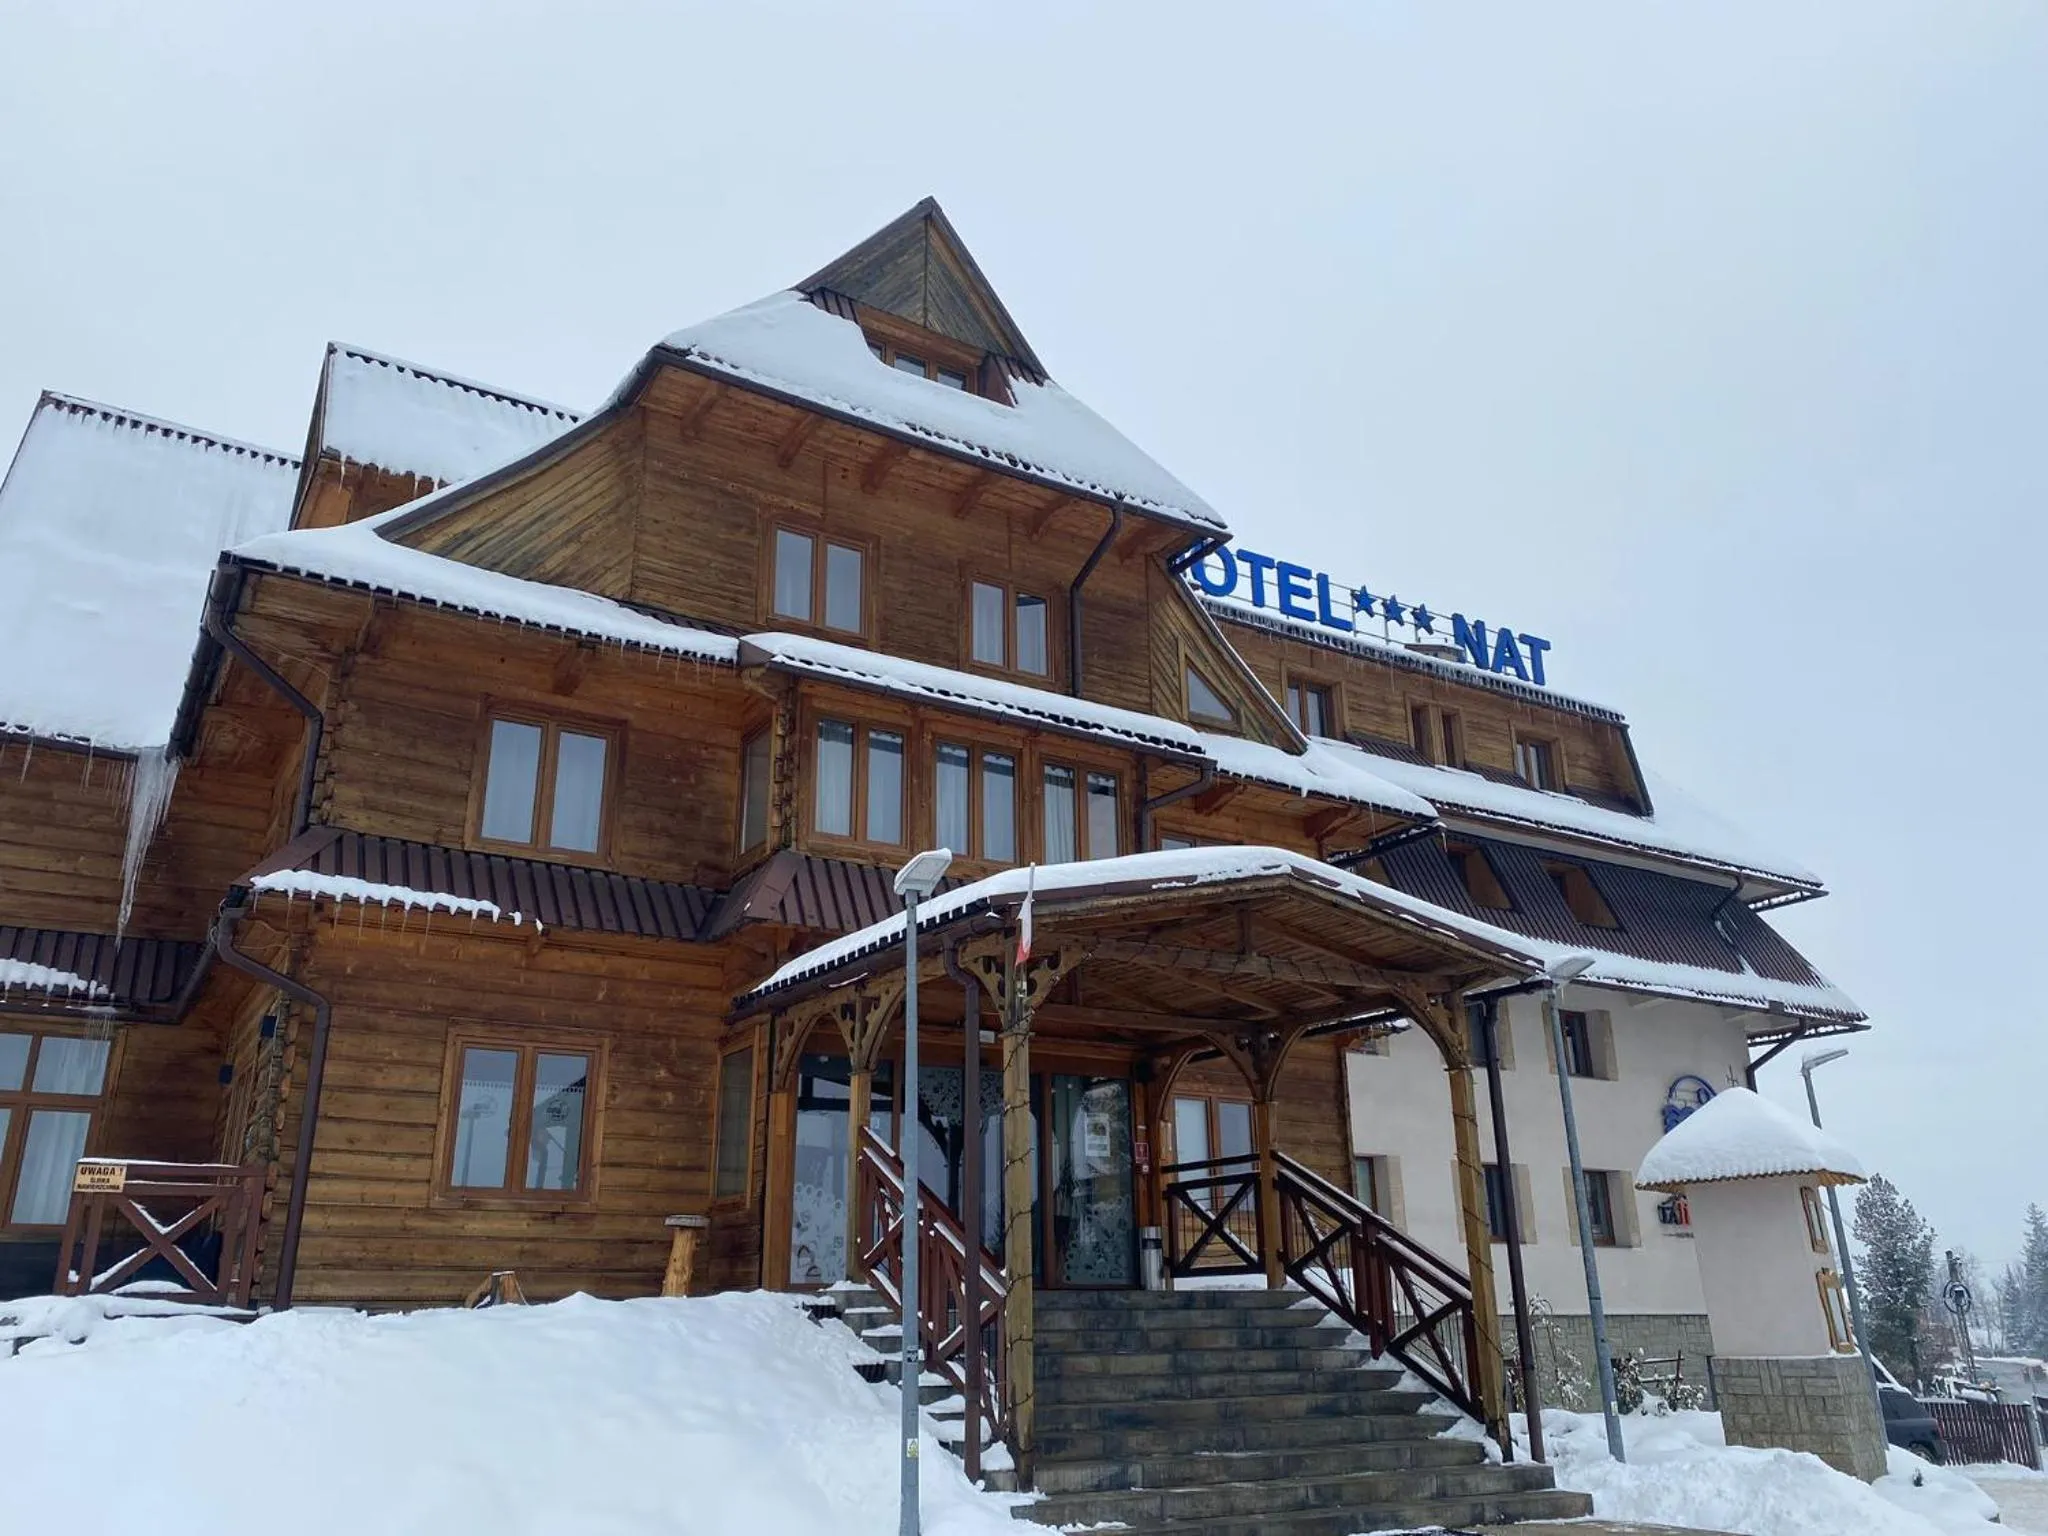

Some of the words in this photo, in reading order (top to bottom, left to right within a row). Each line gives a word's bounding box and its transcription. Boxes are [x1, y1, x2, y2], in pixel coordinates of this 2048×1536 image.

[1186, 543, 1353, 632] OTEL
[1451, 612, 1552, 686] NAT
[80, 1166, 116, 1176] UWAGA
